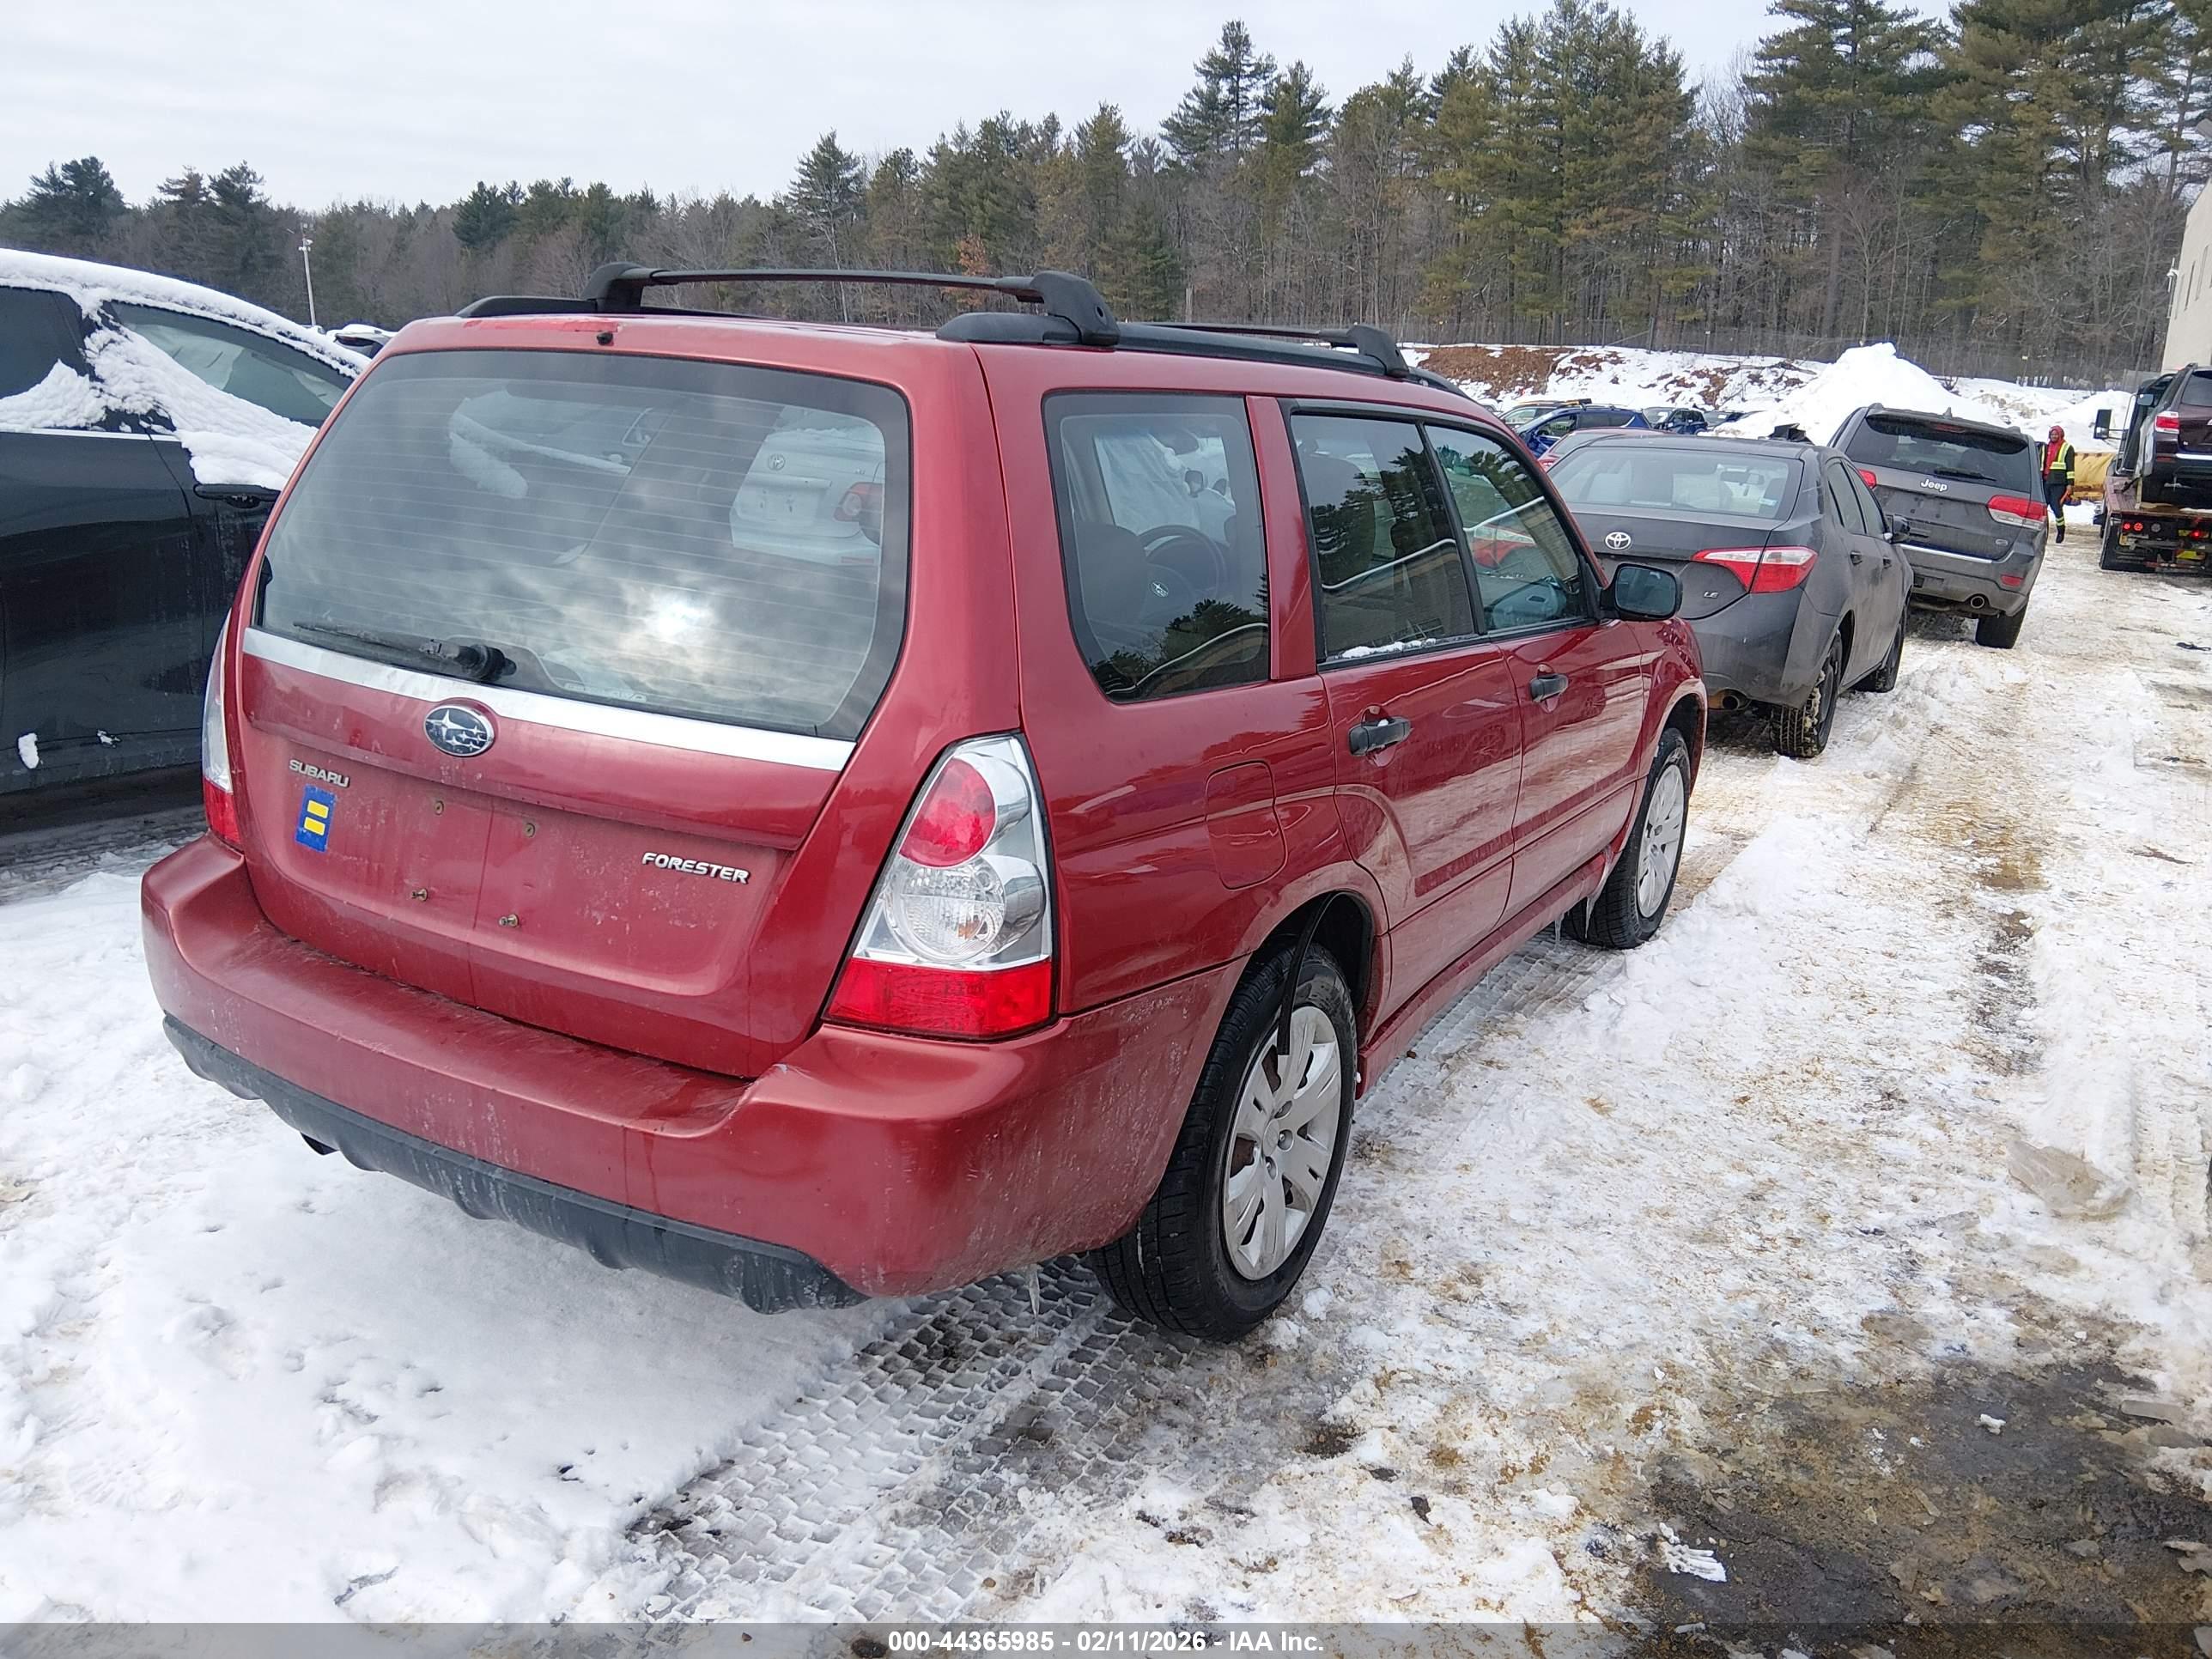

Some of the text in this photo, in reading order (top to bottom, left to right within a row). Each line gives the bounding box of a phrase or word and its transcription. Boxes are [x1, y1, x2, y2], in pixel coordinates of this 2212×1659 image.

[1920, 478, 1948, 492] Jeep
[289, 758, 350, 787] SUBARU
[641, 852, 750, 884] FORESTER
